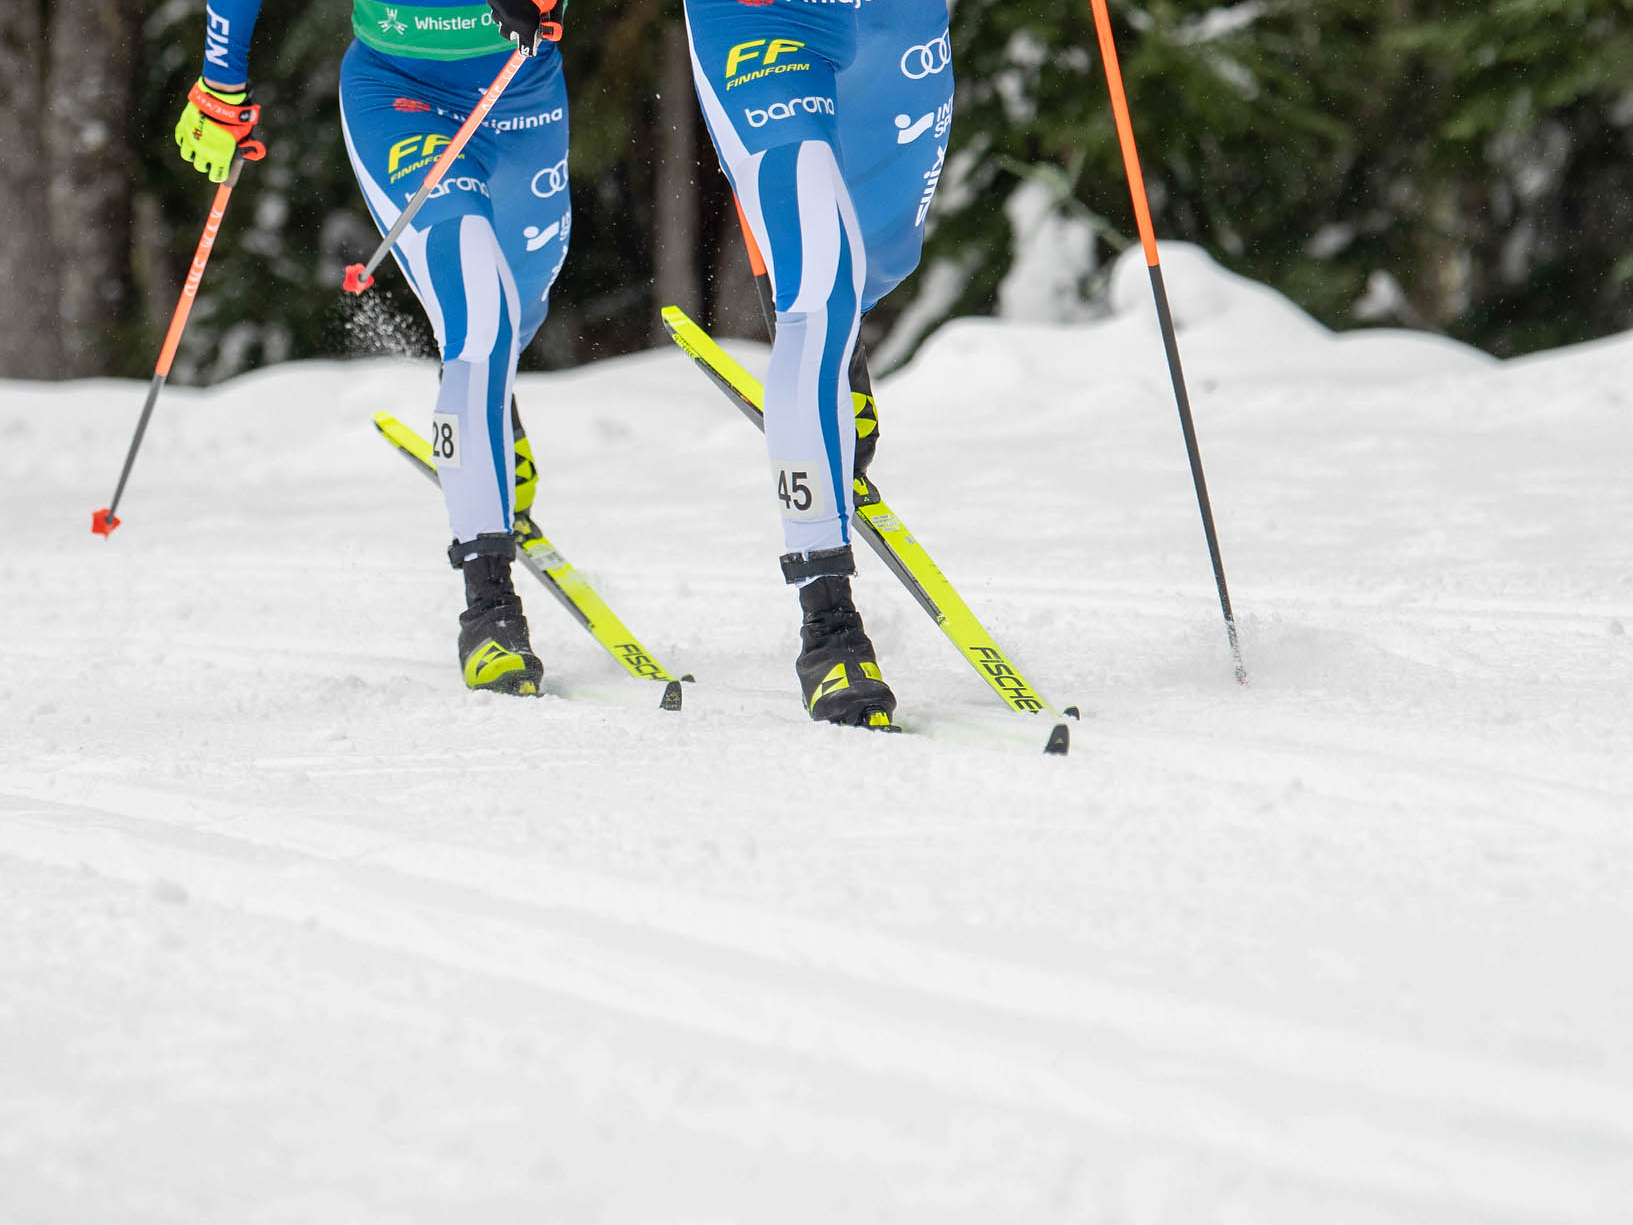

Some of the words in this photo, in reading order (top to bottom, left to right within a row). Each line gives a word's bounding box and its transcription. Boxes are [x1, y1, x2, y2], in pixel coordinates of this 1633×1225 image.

[205, 3, 229, 68] FIN
[415, 14, 475, 32] Whistler
[725, 39, 805, 79] FF
[726, 62, 810, 91] FINNFORM
[744, 96, 834, 128] barona
[433, 421, 454, 459] 28
[778, 470, 812, 511] 45
